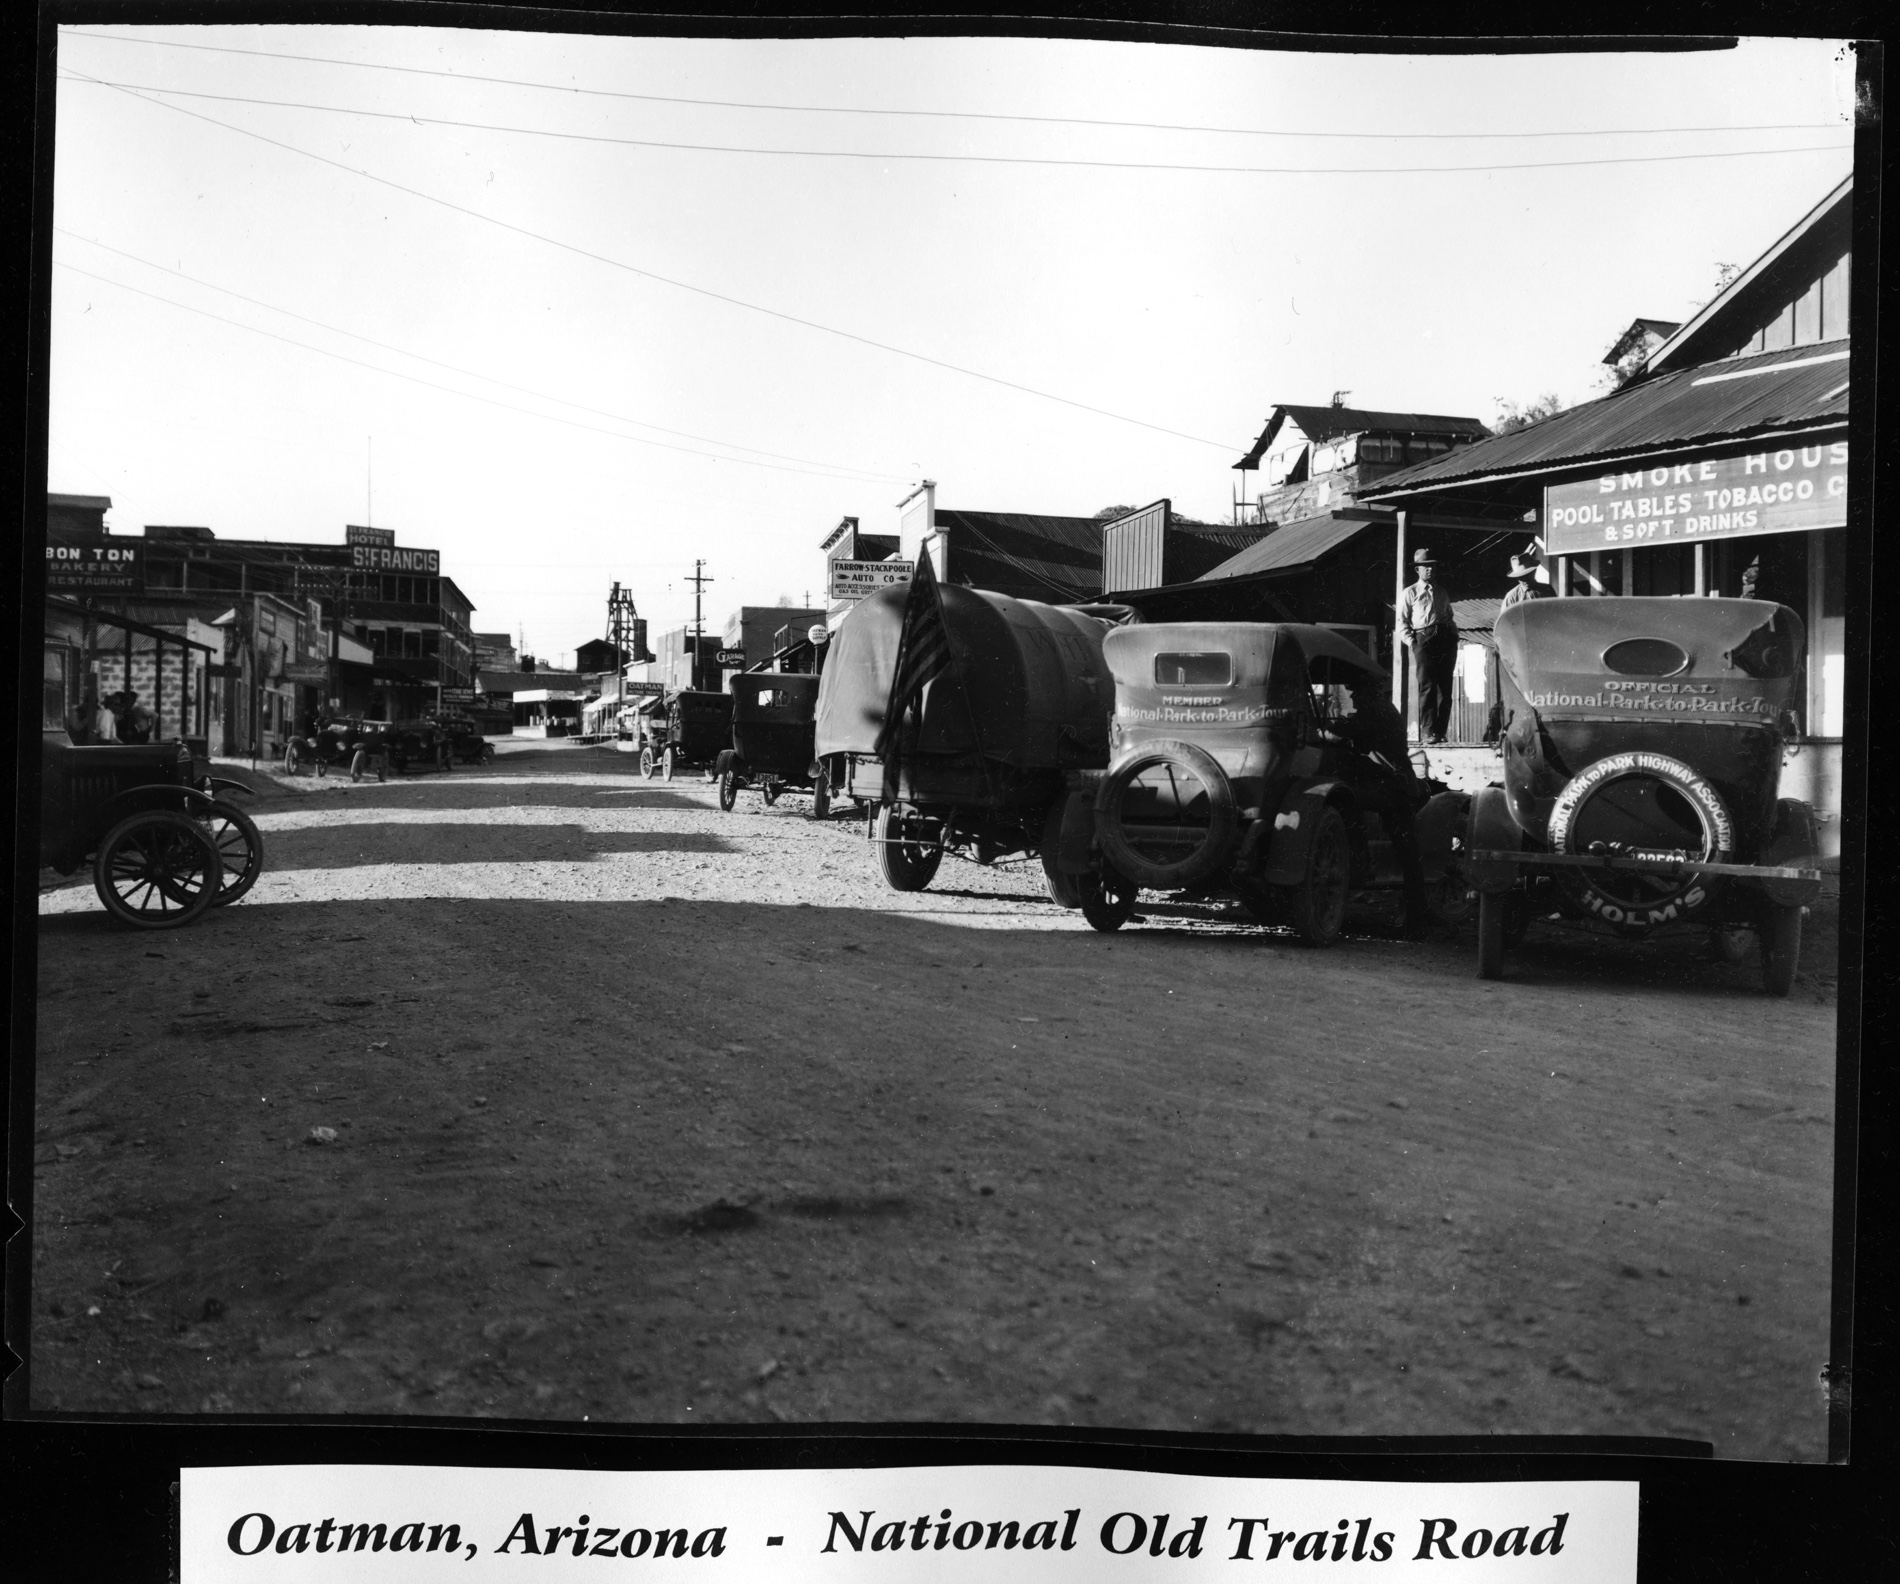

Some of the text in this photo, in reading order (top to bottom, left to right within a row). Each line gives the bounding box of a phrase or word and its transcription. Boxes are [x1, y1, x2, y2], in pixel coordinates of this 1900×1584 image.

[1599, 441, 1848, 493] SMOKE HOUS
[1552, 505, 1603, 528] POOL
[1610, 493, 1692, 521] TABLES
[1705, 479, 1813, 510] TOBACCO
[1605, 509, 1758, 541] & SOFT DRINKS
[349, 534, 390, 546] HOTEL
[46, 547, 135, 561] BON TON
[370, 548, 438, 572] FRANCIS
[50, 562, 125, 572] BAKERY
[48, 576, 134, 586] RESTAURANT
[852, 574, 895, 583] AUTO CO
[716, 651, 745, 663] GARAGE
[1604, 681, 1717, 695] OFFICIAL
[1162, 696, 1223, 706] MEMBER
[1564, 775, 1592, 807] PARK
[1587, 770, 1600, 782] TO
[1598, 755, 1636, 776] PARK
[1638, 755, 1697, 785] HIGHWAY
[1691, 782, 1731, 852] ASSOCIATION
[1581, 886, 1706, 926] HOLM'S
